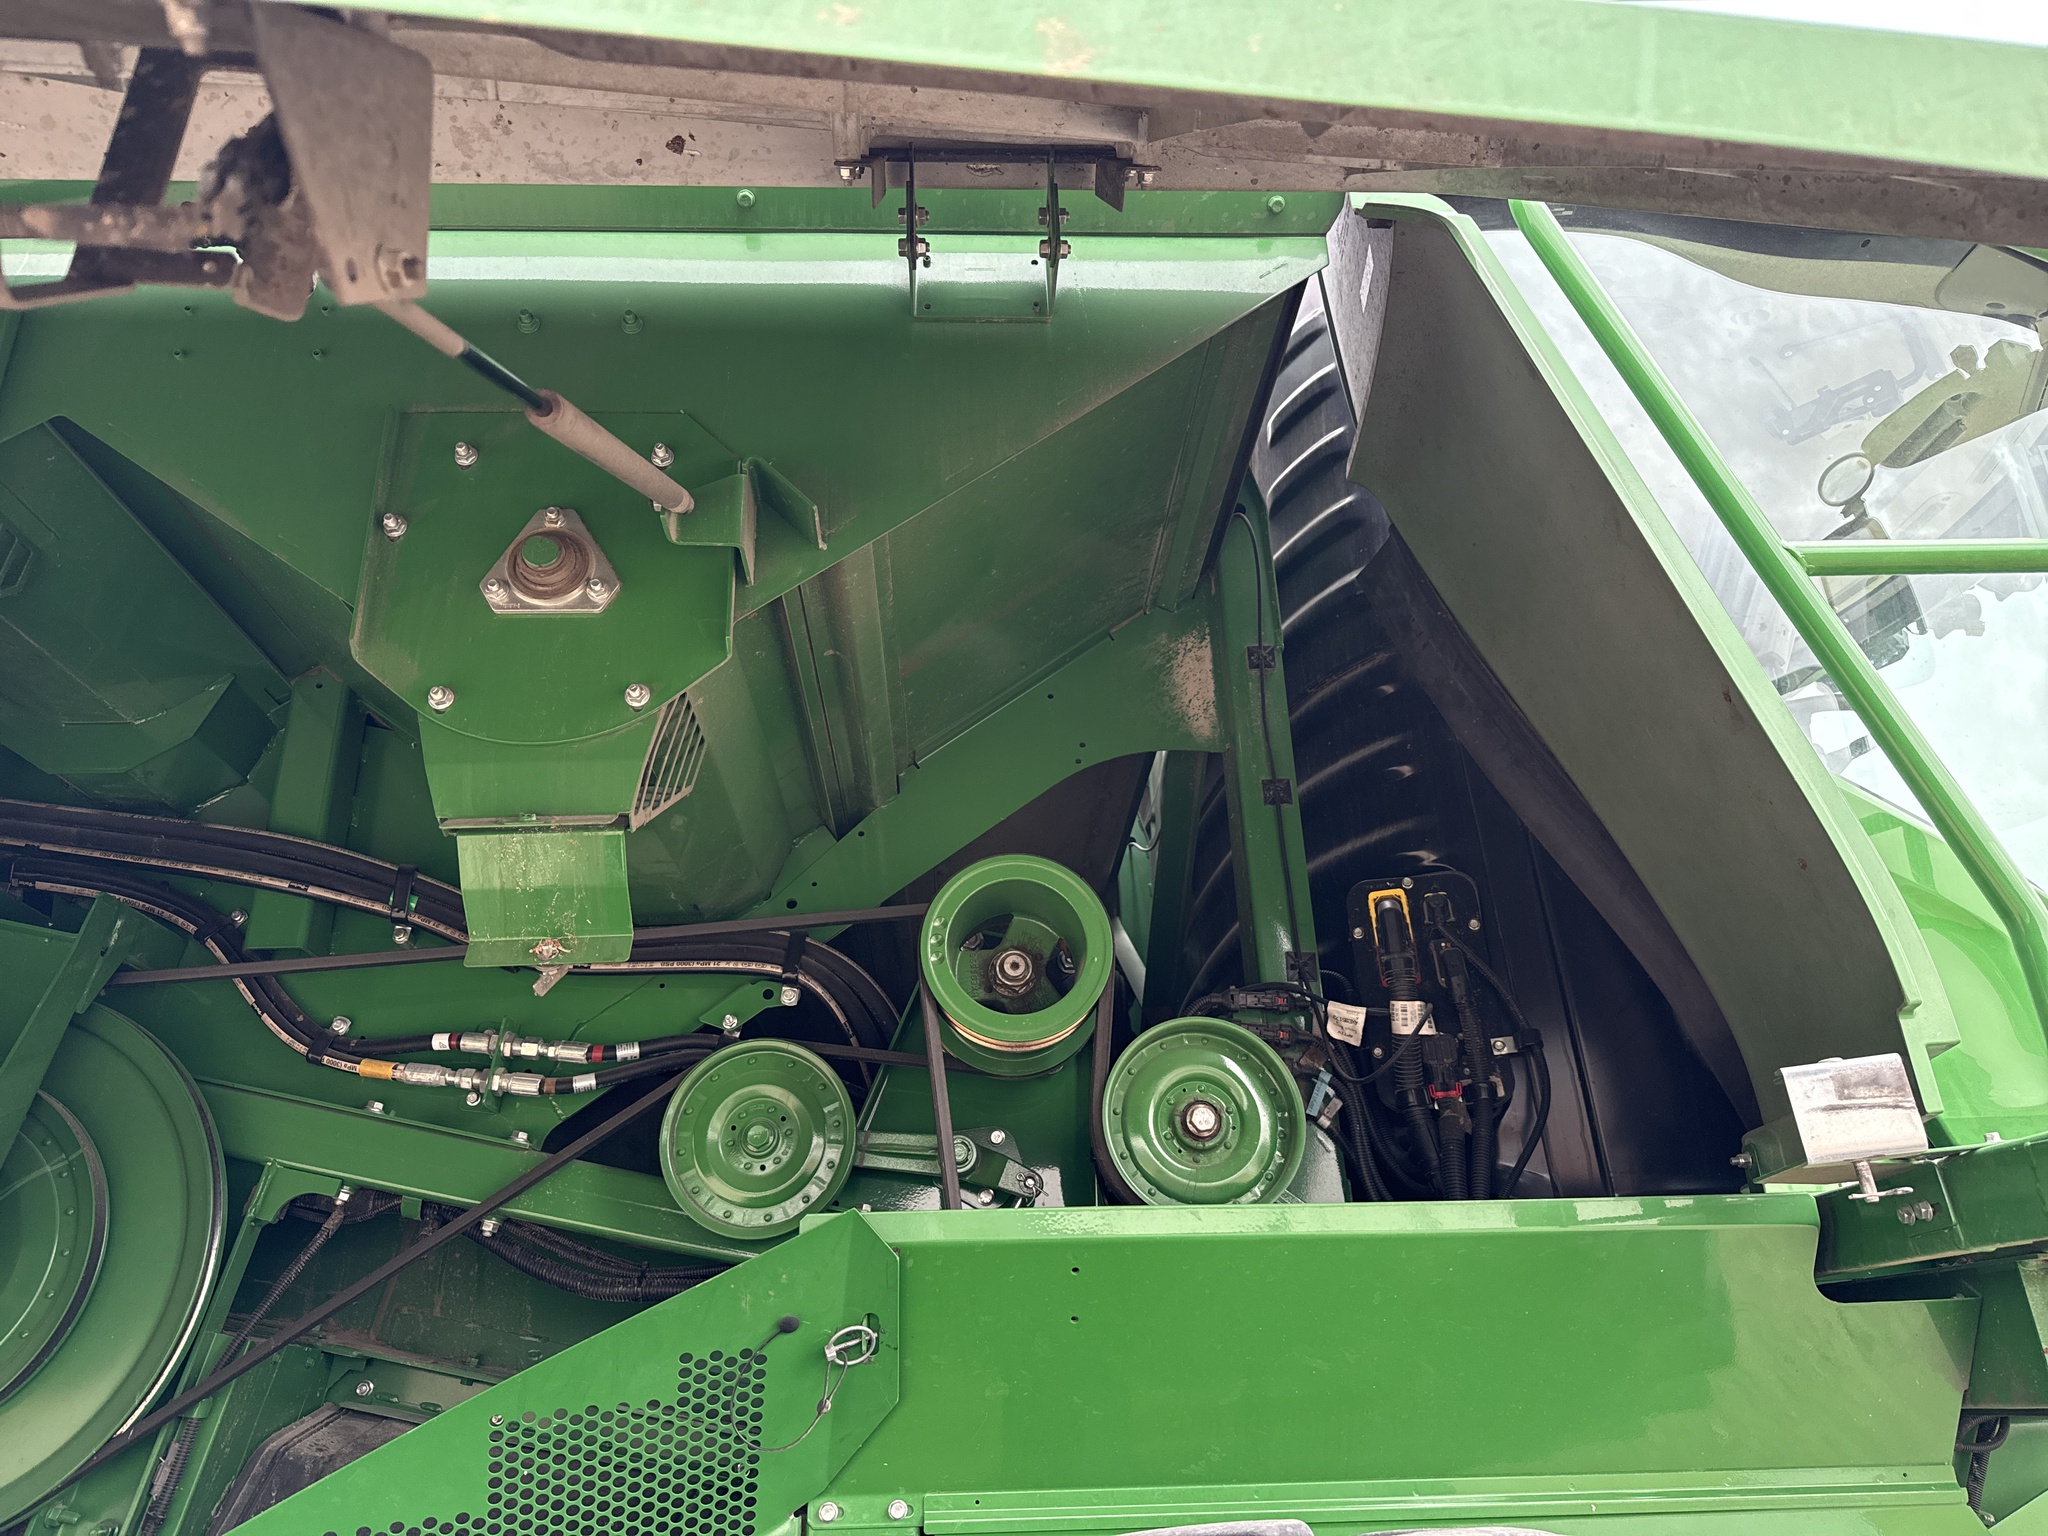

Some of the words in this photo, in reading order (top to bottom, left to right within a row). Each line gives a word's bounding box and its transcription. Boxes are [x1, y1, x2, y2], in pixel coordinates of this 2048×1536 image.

[123, 897, 141, 907] (3000
[141, 903, 155, 914] MPa
[417, 915, 431, 927] MPa
[325, 1058, 343, 1068] (3000
[343, 1063, 358, 1072] MPa
